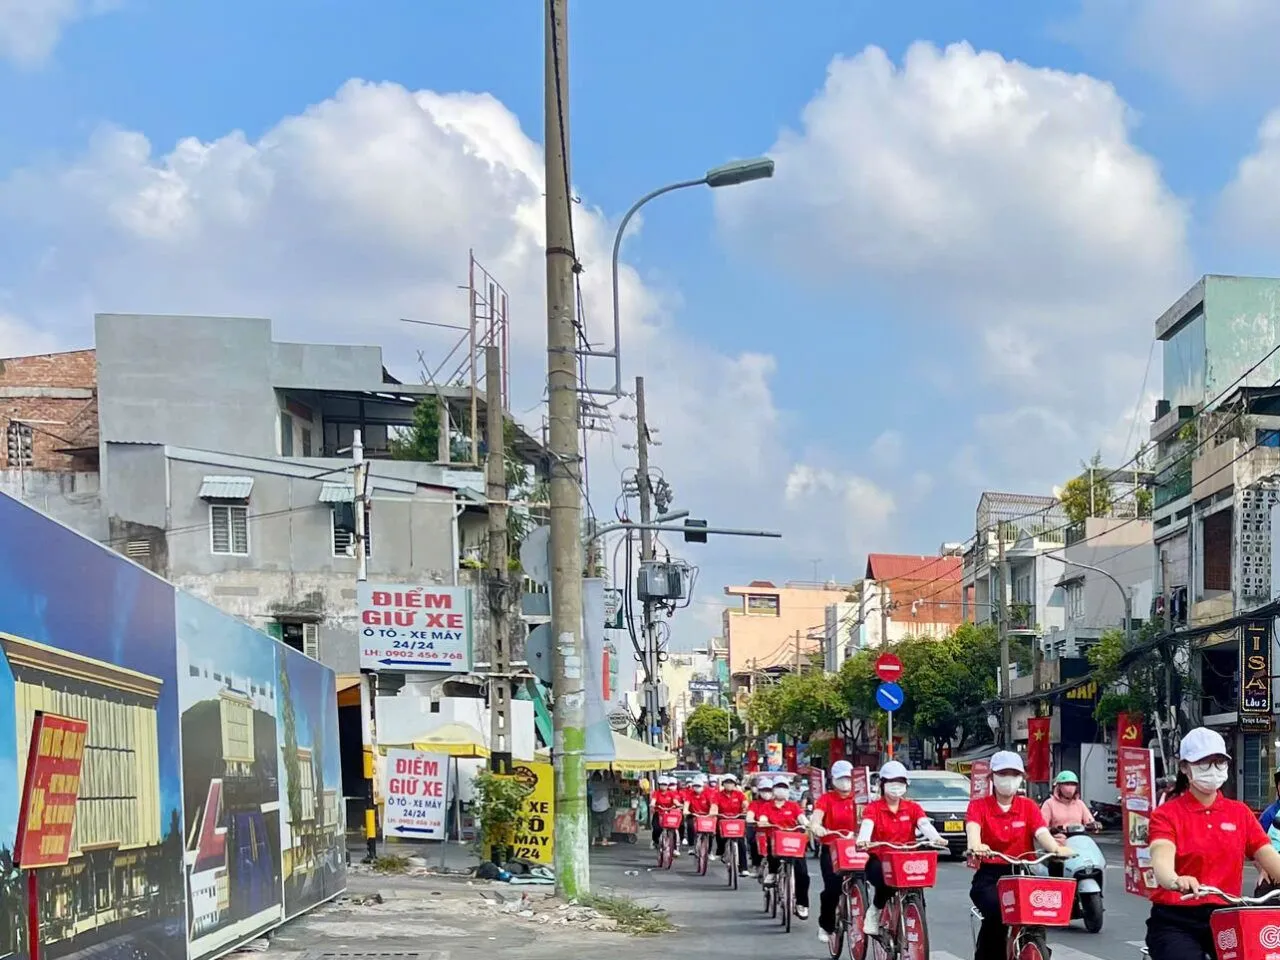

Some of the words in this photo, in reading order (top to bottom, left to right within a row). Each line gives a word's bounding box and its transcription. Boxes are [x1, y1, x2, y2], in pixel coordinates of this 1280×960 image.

[371, 587, 452, 609] ĐIỂM
[362, 608, 417, 627] GIỮ
[426, 613, 464, 629] XE
[363, 627, 374, 637] Ô
[379, 627, 397, 638] TÔ
[410, 630, 427, 640] XE
[431, 630, 462, 640] MÁY
[393, 640, 434, 650] 24/24
[365, 649, 382, 657] LH:
[385, 650, 414, 658] 0902
[417, 651, 439, 659] 456
[442, 652, 463, 660] 768
[1262, 699, 1267, 707] 2
[396, 754, 438, 776] ĐIỂM
[389, 776, 418, 796] GIỮ
[422, 780, 443, 797] XE
[388, 797, 395, 806] Ô
[396, 799, 408, 807] TÔ
[413, 800, 424, 808] XE
[425, 800, 442, 809] MÁY
[529, 801, 549, 814] XE
[403, 808, 427, 818] 24/24
